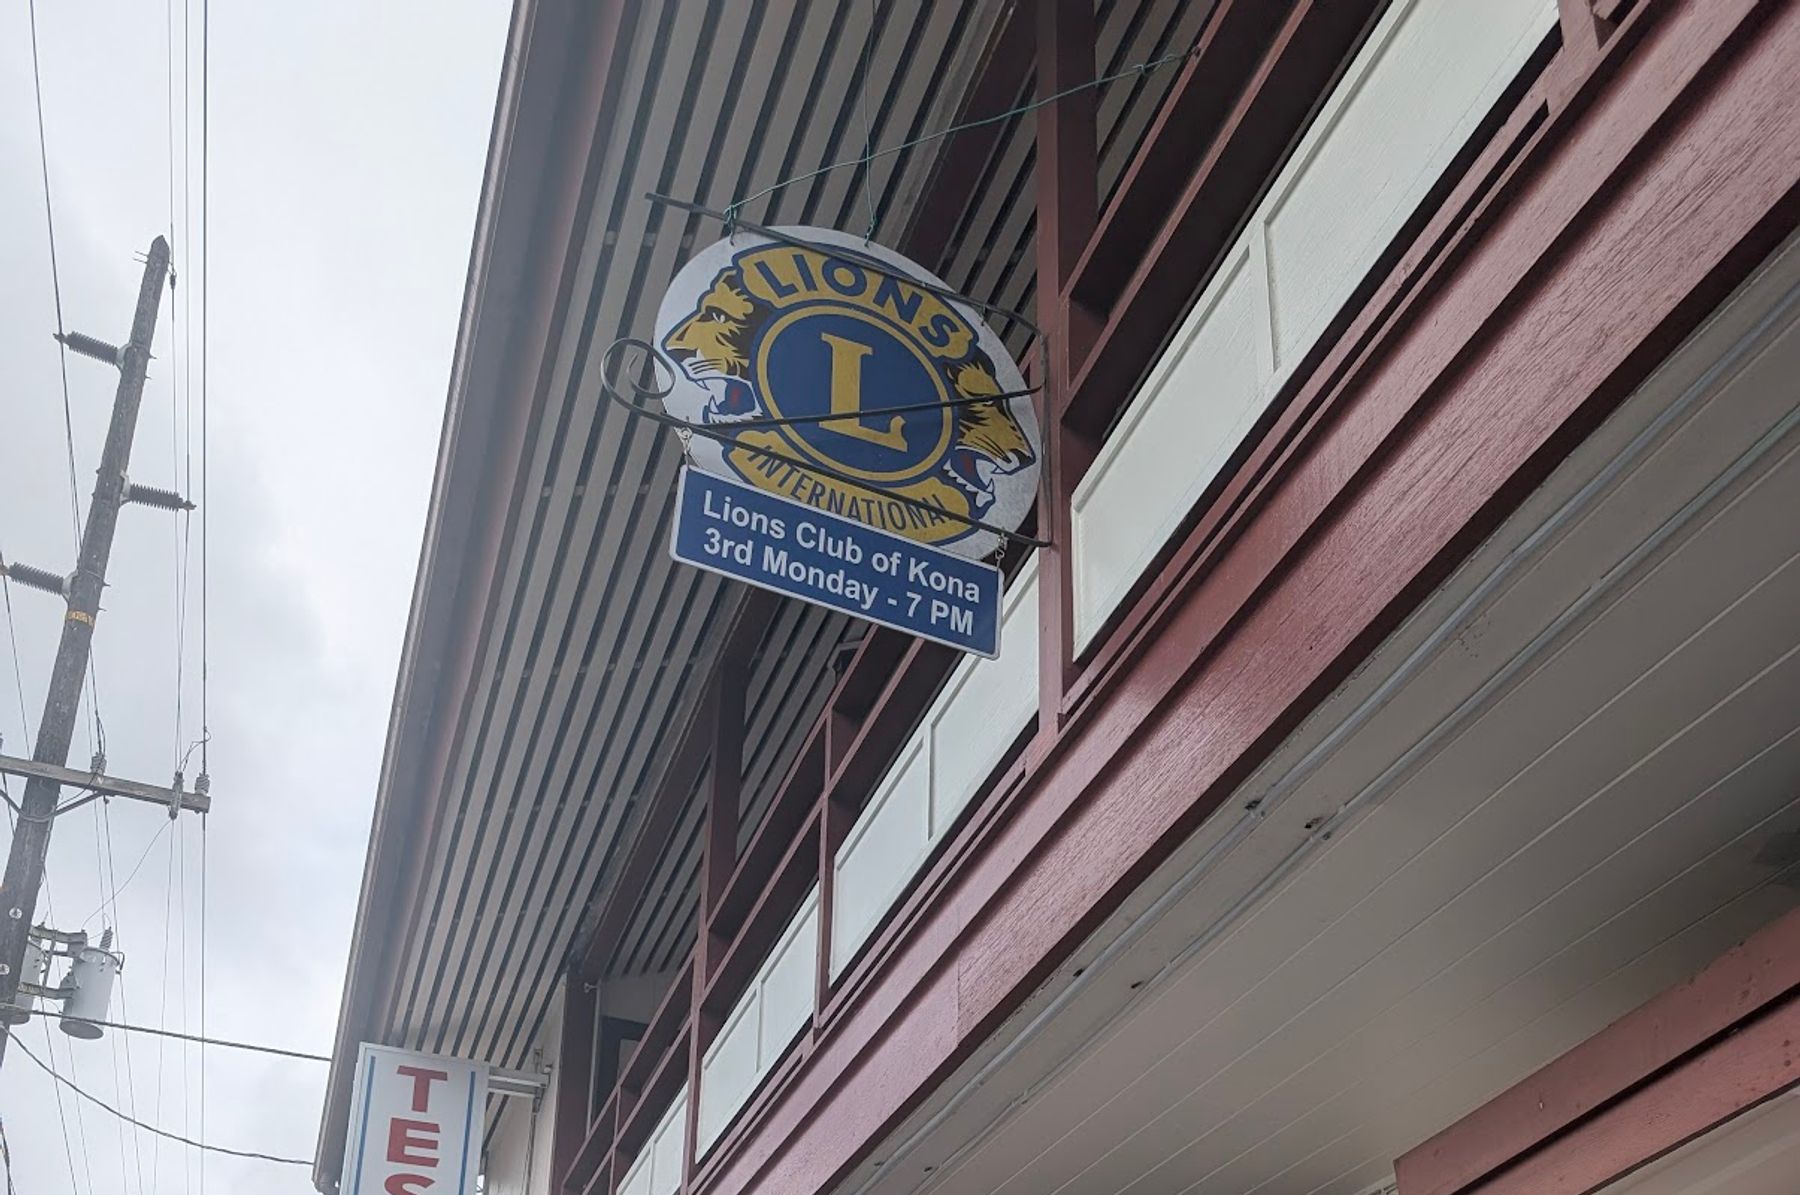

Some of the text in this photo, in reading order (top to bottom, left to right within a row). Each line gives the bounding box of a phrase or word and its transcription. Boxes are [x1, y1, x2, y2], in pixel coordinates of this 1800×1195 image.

[754, 254, 959, 348] LIONS
[818, 332, 908, 452] L
[703, 490, 981, 604] Lions Club of Kona
[703, 528, 753, 566] 3rd
[762, 545, 879, 611] Monday
[906, 591, 923, 618] 7
[931, 600, 974, 636] PM
